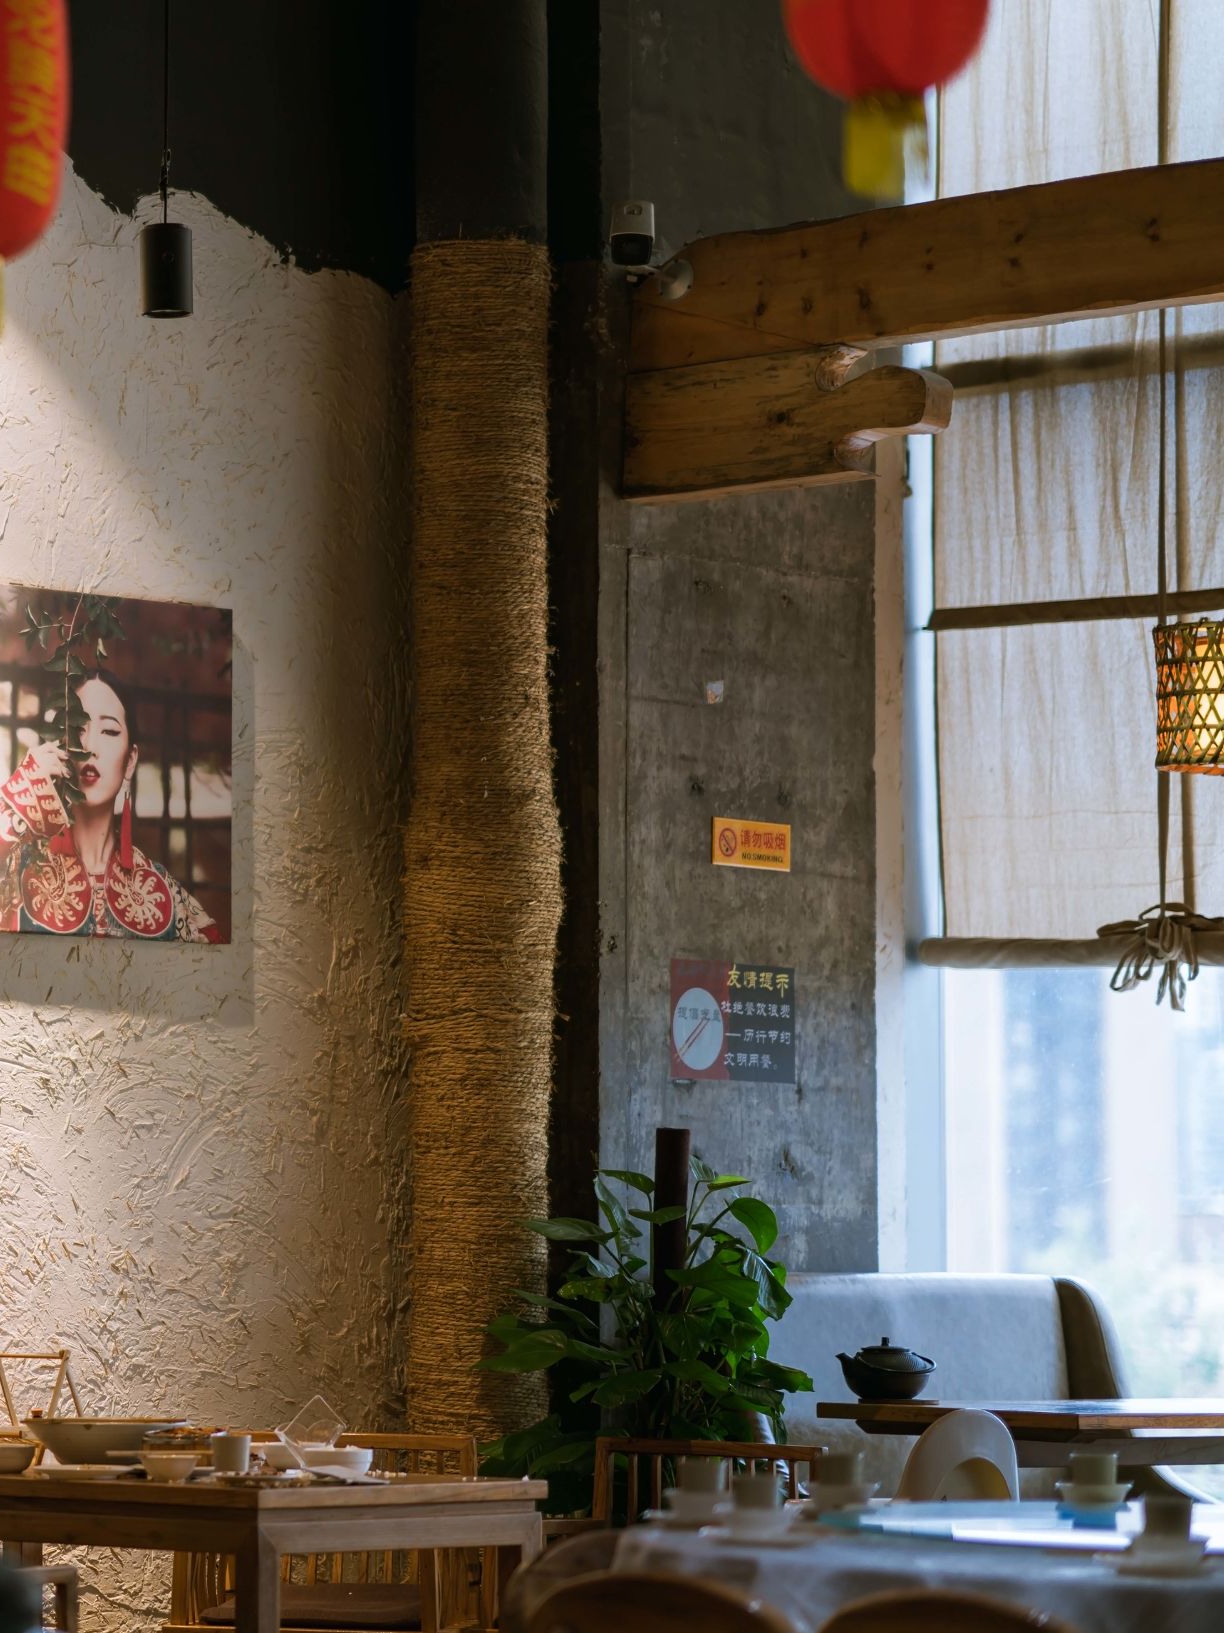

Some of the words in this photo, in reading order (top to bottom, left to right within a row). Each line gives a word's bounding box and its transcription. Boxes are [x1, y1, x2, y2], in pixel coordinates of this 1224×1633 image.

[740, 829, 786, 851] 请勿吸烟
[741, 852, 752, 860] NO
[752, 853, 783, 863] SMOKING
[727, 964, 789, 998] 友情提示
